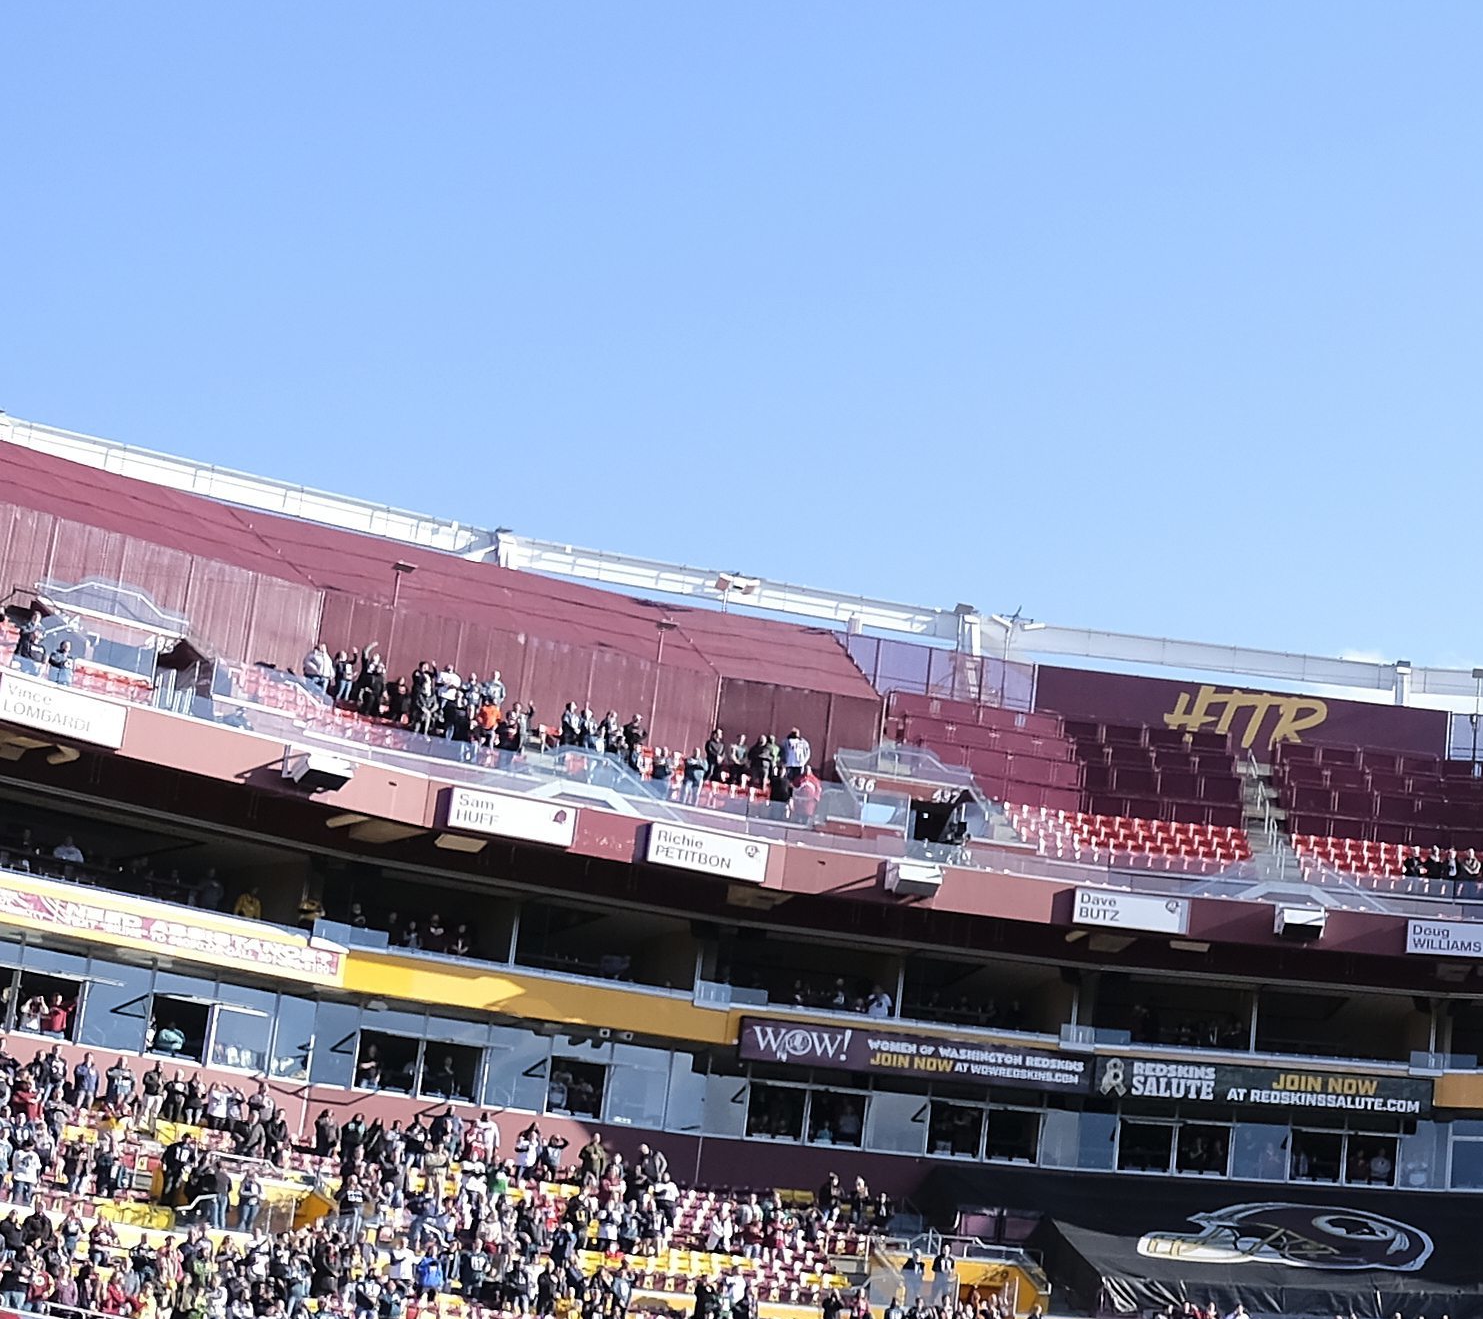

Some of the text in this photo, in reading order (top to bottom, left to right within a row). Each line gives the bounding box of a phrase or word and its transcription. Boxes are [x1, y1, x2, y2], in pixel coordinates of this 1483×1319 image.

[7, 683, 52, 705] Vince
[3, 700, 91, 732] LOMBARDI
[459, 793, 495, 811] Sam
[456, 811, 499, 827] HUFF
[658, 830, 704, 849] Richie
[655, 844, 731, 870] PETITBON
[1080, 892, 1117, 908] Dave
[1079, 906, 1120, 922] BUTZ
[1412, 924, 1450, 939] Doug
[1412, 936, 1481, 953] WILLIAMS
[868, 1039, 1084, 1072] WOMEN OF WASHINGTON REDSKINS
[871, 1053, 909, 1068] JOIN
[913, 1057, 952, 1073] NOW
[954, 1064, 968, 1073] AT
[1133, 1062, 1216, 1080] REDSKINS
[1131, 1076, 1214, 1100] SALUTE
[1272, 1074, 1378, 1096] JOIN NOW
[1227, 1088, 1420, 1113] AT REDSKINSSALUTE.COM
